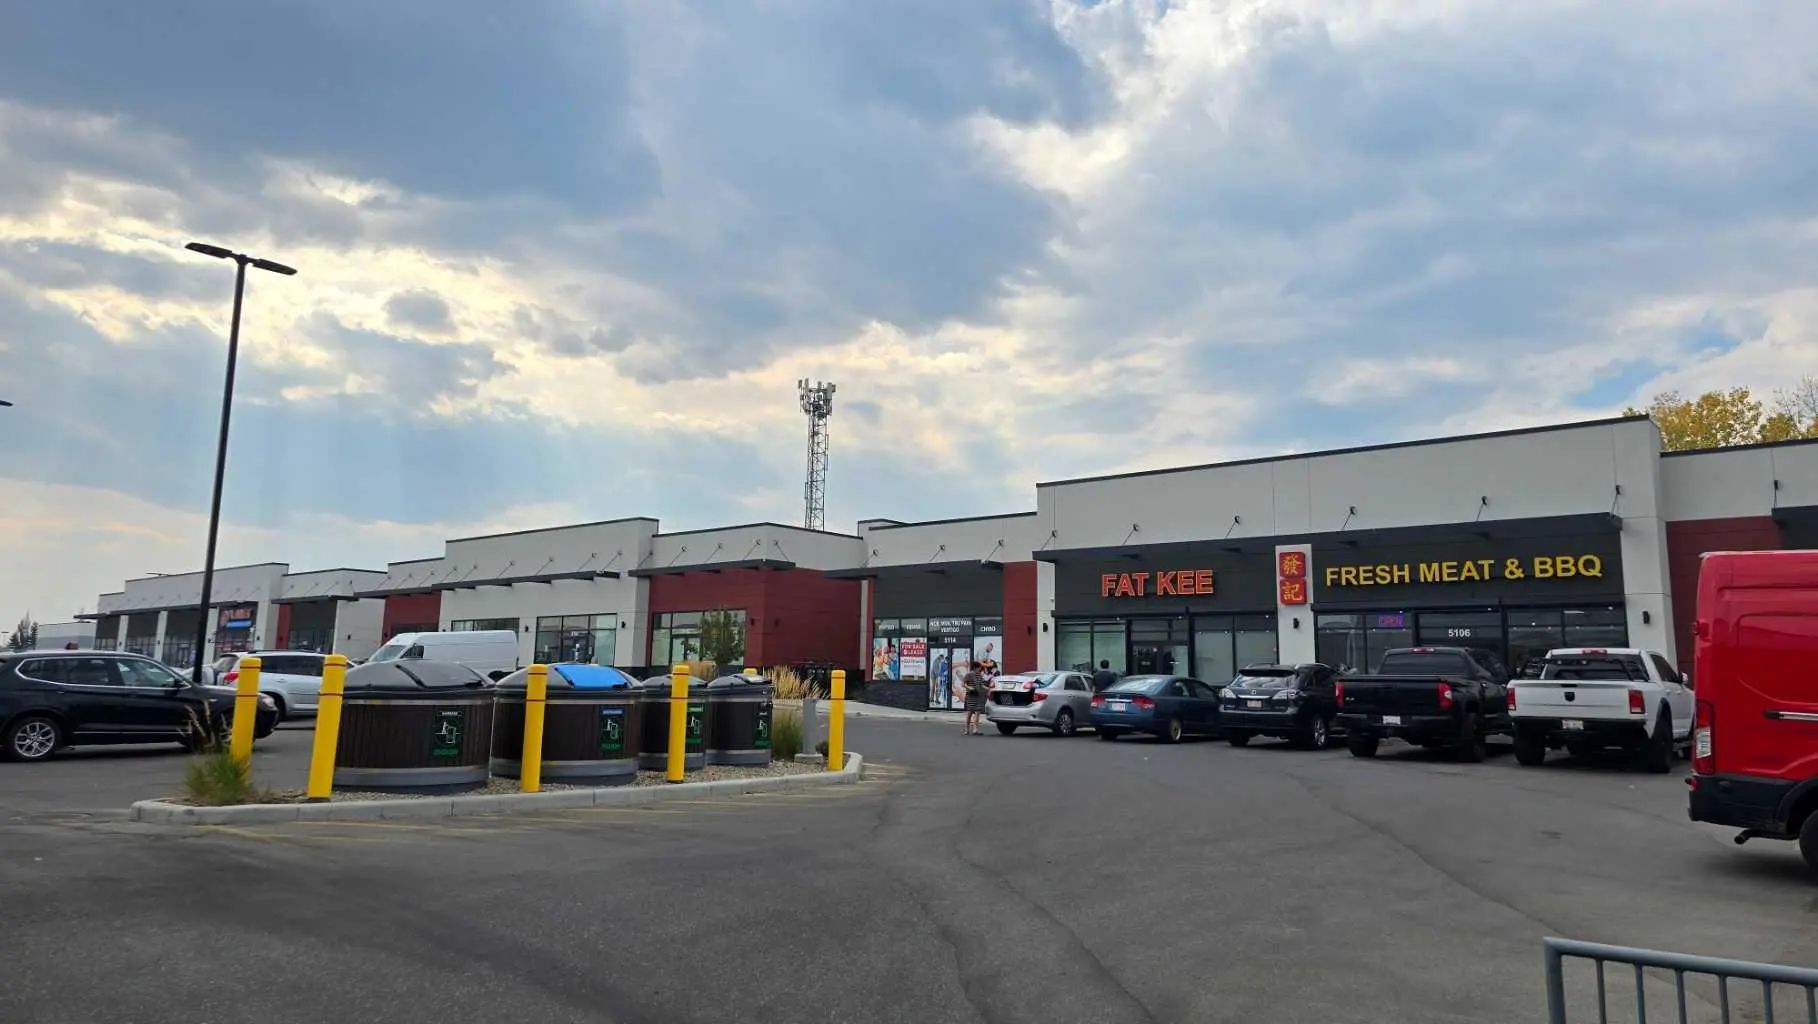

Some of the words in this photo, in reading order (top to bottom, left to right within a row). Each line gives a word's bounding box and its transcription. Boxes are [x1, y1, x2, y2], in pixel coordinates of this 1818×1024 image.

[1102, 572, 1150, 597] FAT
[1157, 569, 1214, 596] KEE
[1281, 553, 1303, 602] 發記
[1325, 564, 1410, 586] FRESH
[1419, 559, 1495, 583] MEAT
[1504, 558, 1525, 579] &
[1533, 554, 1603, 579] BBQ
[1448, 628, 1472, 638] 5106
